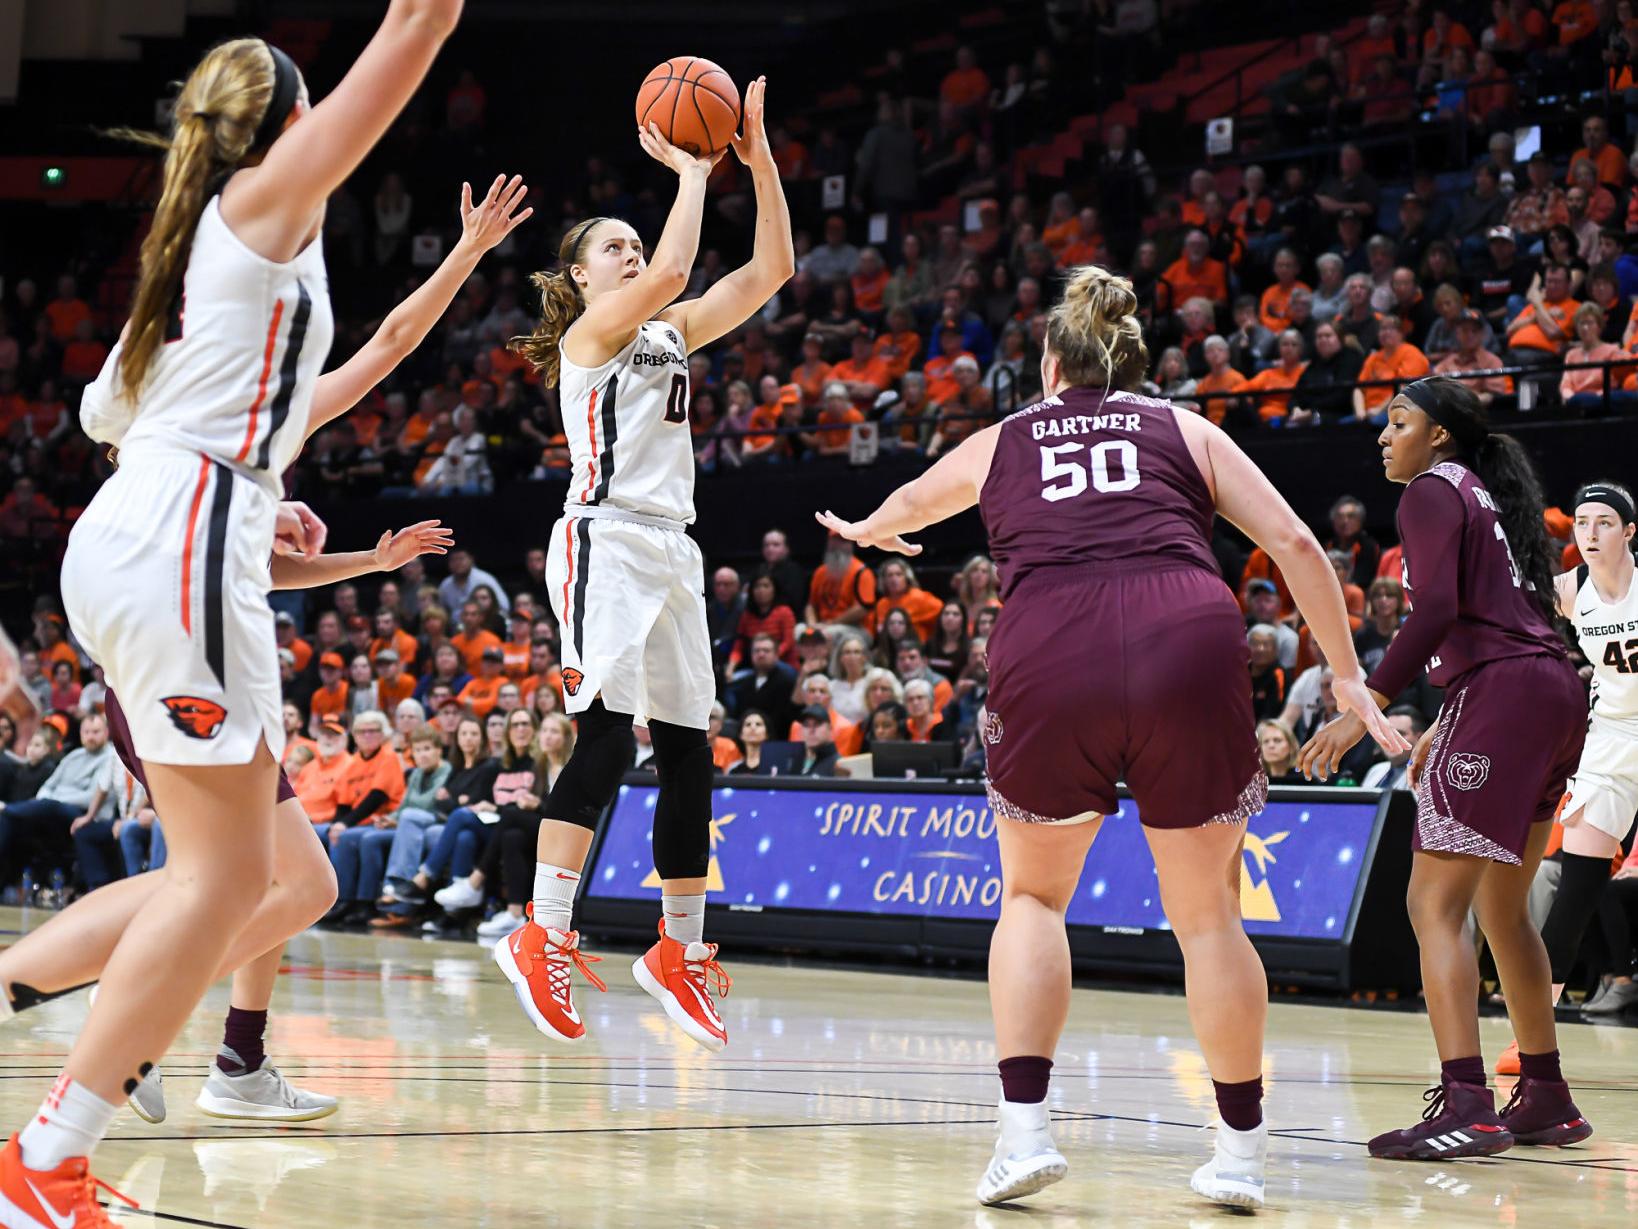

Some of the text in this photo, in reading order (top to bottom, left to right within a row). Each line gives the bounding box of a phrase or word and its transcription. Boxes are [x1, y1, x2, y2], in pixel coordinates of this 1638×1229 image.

[664, 372, 688, 424] 0
[1032, 413, 1141, 440] GARTNER
[1040, 440, 1140, 502] 50
[1582, 623, 1625, 637] OREGON
[1603, 639, 1638, 674] 42
[820, 802, 918, 837] SPIRIT
[873, 871, 1001, 907] CASINO
